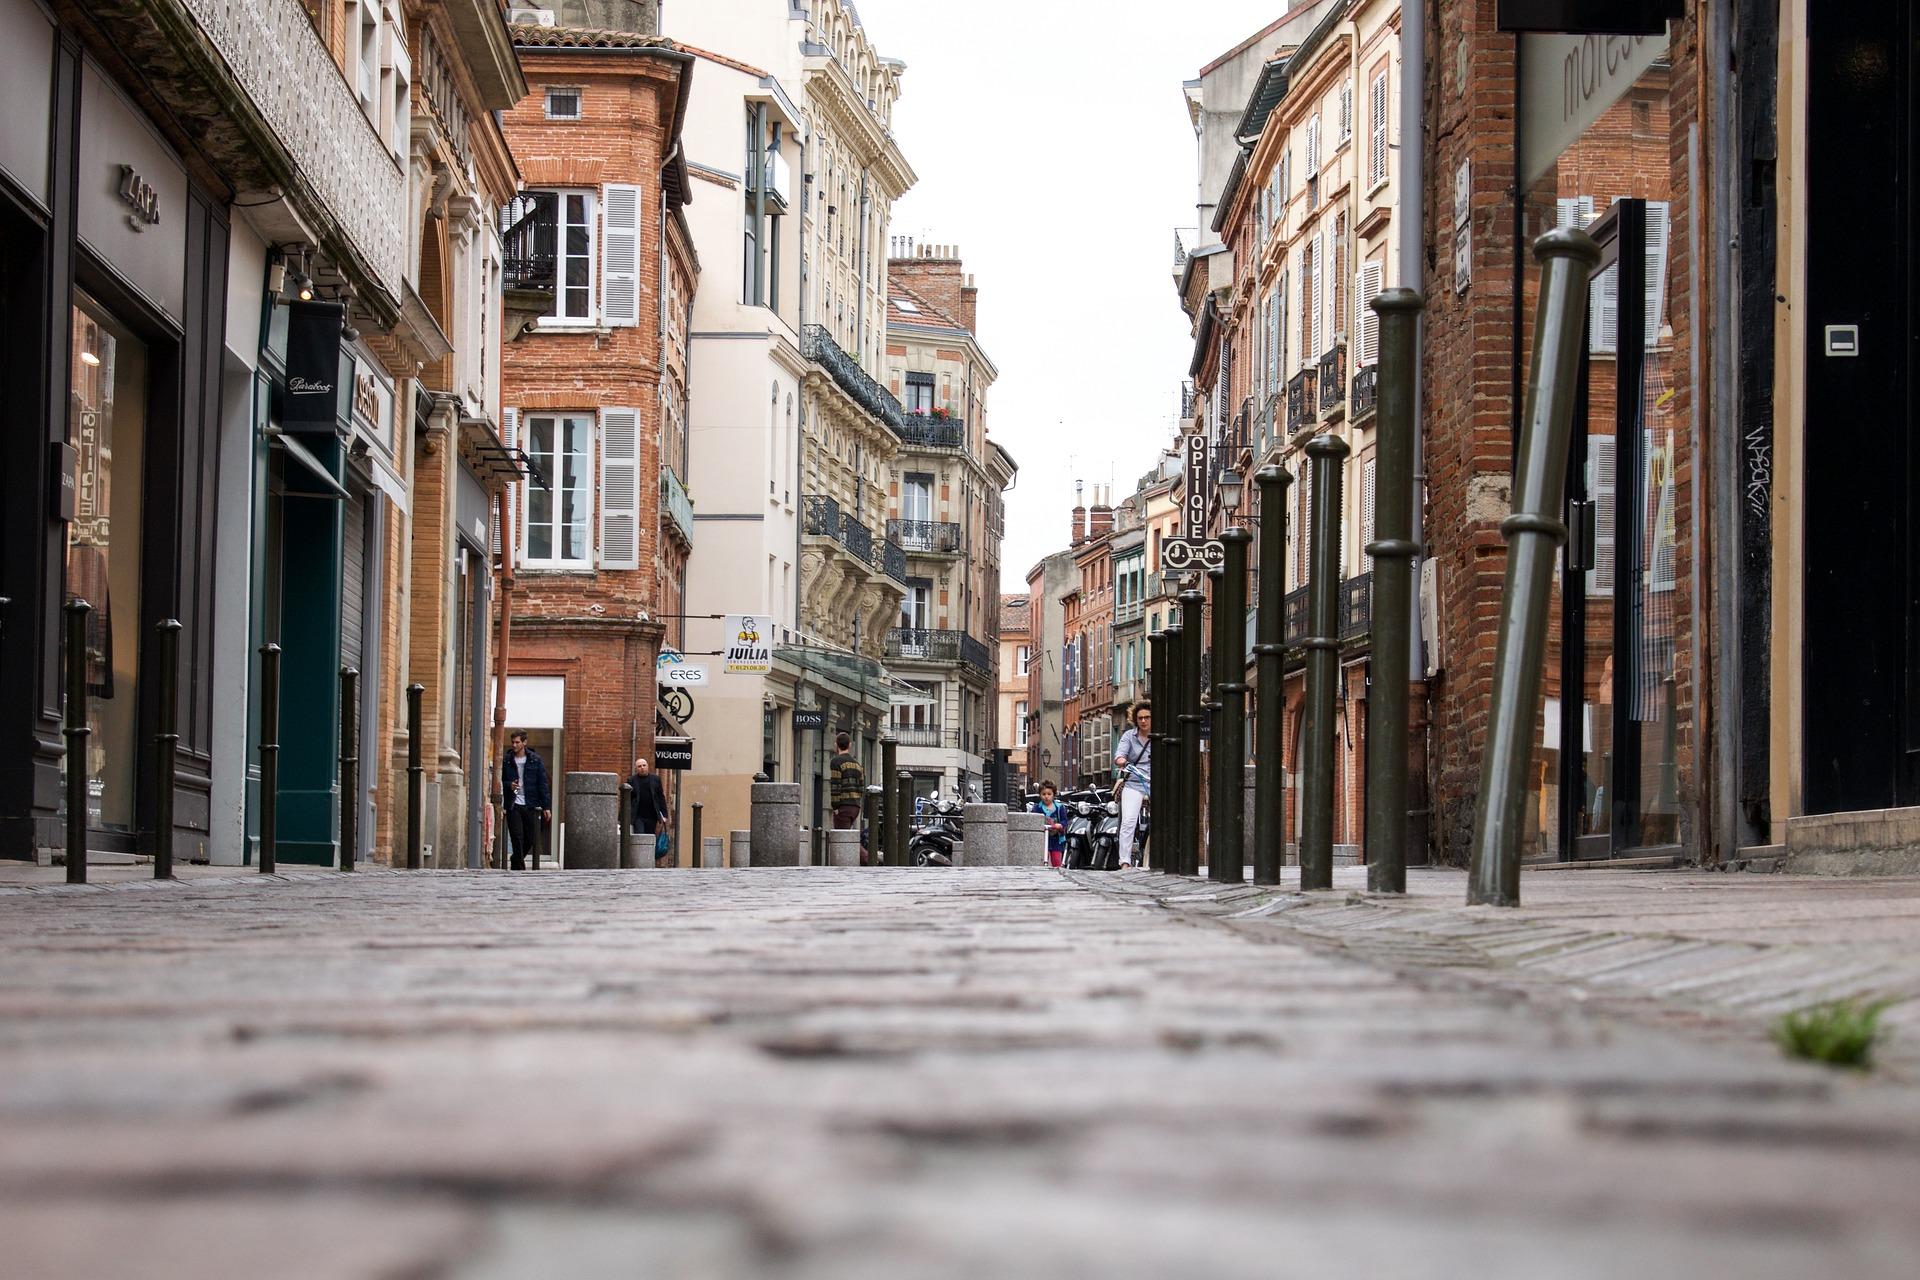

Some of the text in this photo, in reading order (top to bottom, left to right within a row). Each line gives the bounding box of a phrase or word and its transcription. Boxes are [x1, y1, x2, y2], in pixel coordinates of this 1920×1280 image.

[119, 164, 161, 225] ZAPA
[290, 377, 333, 392] Paraboot
[62, 472, 75, 490] ZAPA
[1191, 436, 1204, 539] OPTIQUE
[728, 648, 768, 660] JUILIA
[670, 670, 702, 680] ERES
[796, 715, 822, 723] BOSS
